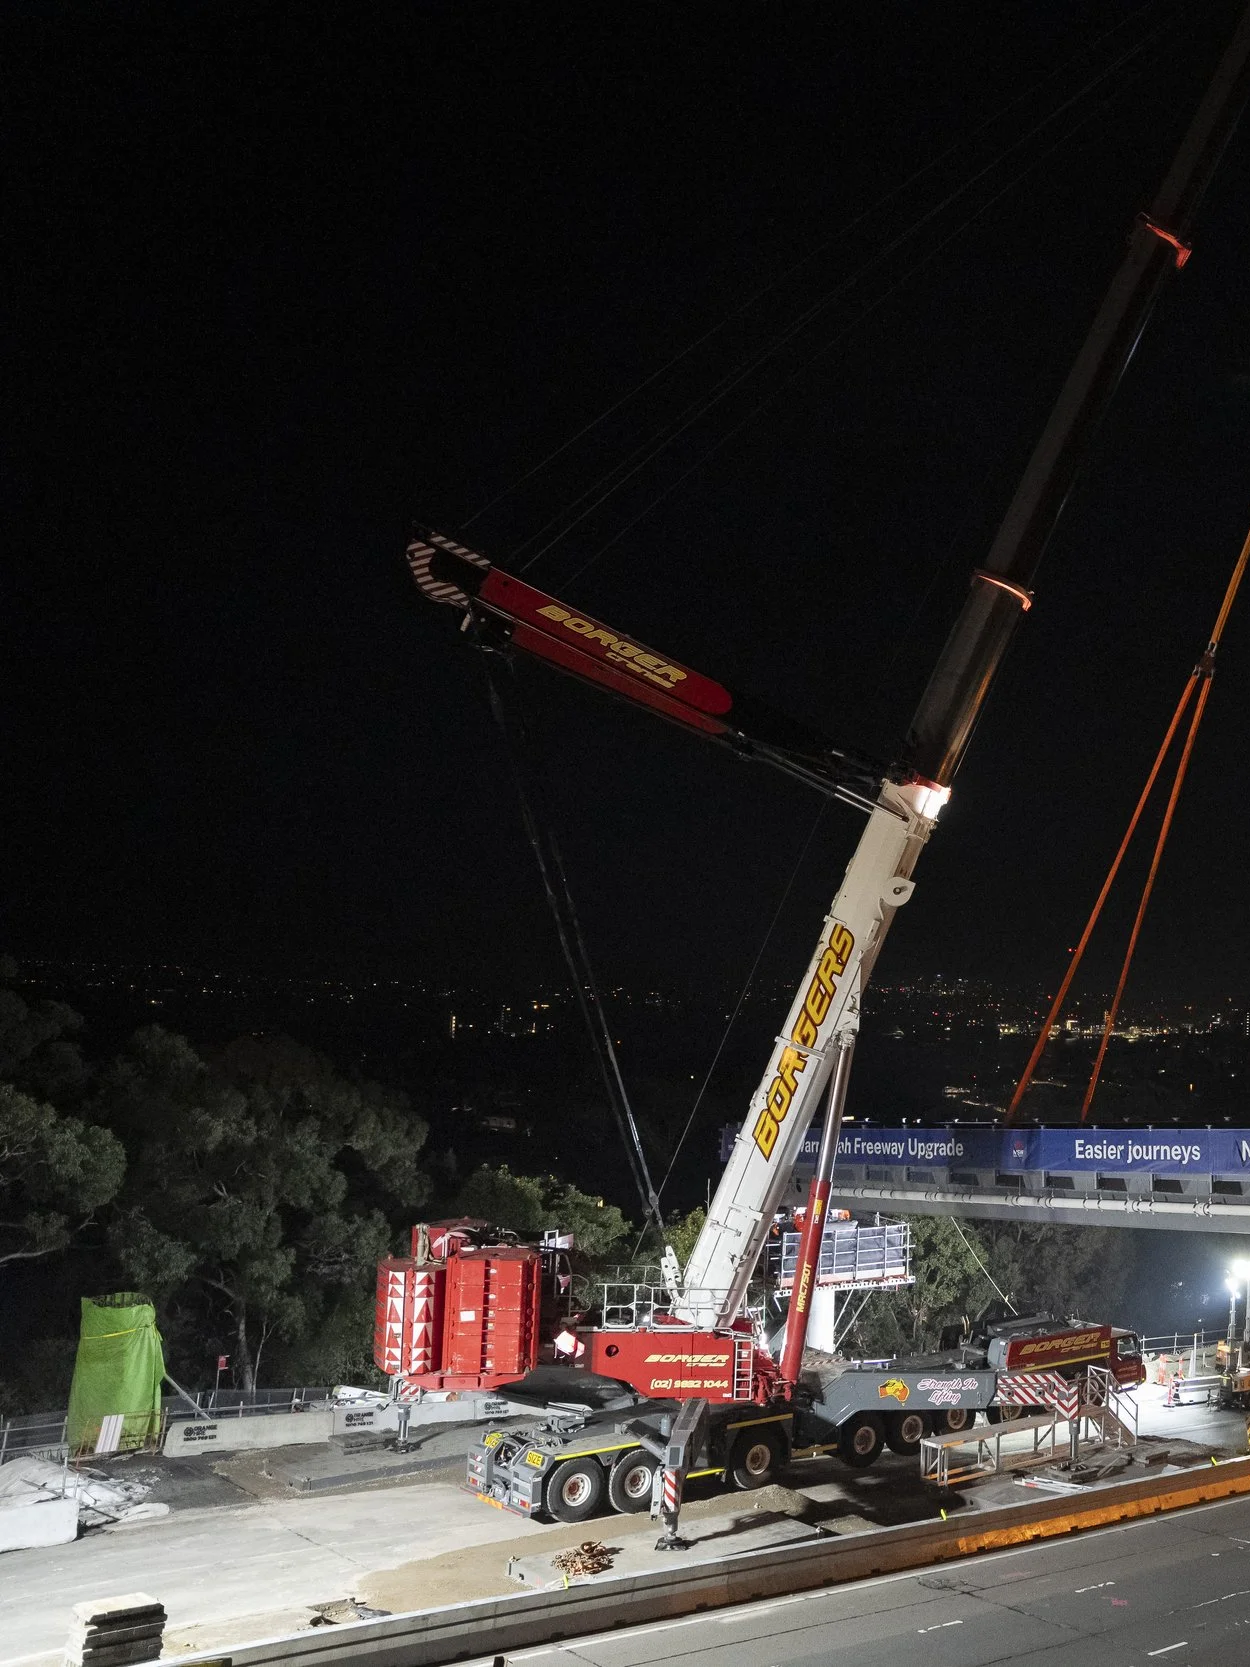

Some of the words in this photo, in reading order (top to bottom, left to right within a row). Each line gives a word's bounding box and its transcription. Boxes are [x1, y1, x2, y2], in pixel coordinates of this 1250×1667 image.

[536, 604, 687, 682] BORGER
[752, 923, 855, 1162] BORGERS
[854, 1137, 905, 1159] Freeway
[908, 1138, 964, 1160] Upgrade
[1075, 1139, 1124, 1160] Easier
[1126, 1139, 1201, 1165] journeys
[1019, 1332, 1101, 1355] BORGER
[644, 1354, 731, 1363] BORGER
[650, 1379, 672, 1390] (02)
[703, 1380, 729, 1388] 1044
[917, 1378, 962, 1392] Strength
[962, 1378, 979, 1390] In
[928, 1390, 961, 1406] Lifting
[527, 1451, 543, 1466] SIZE
